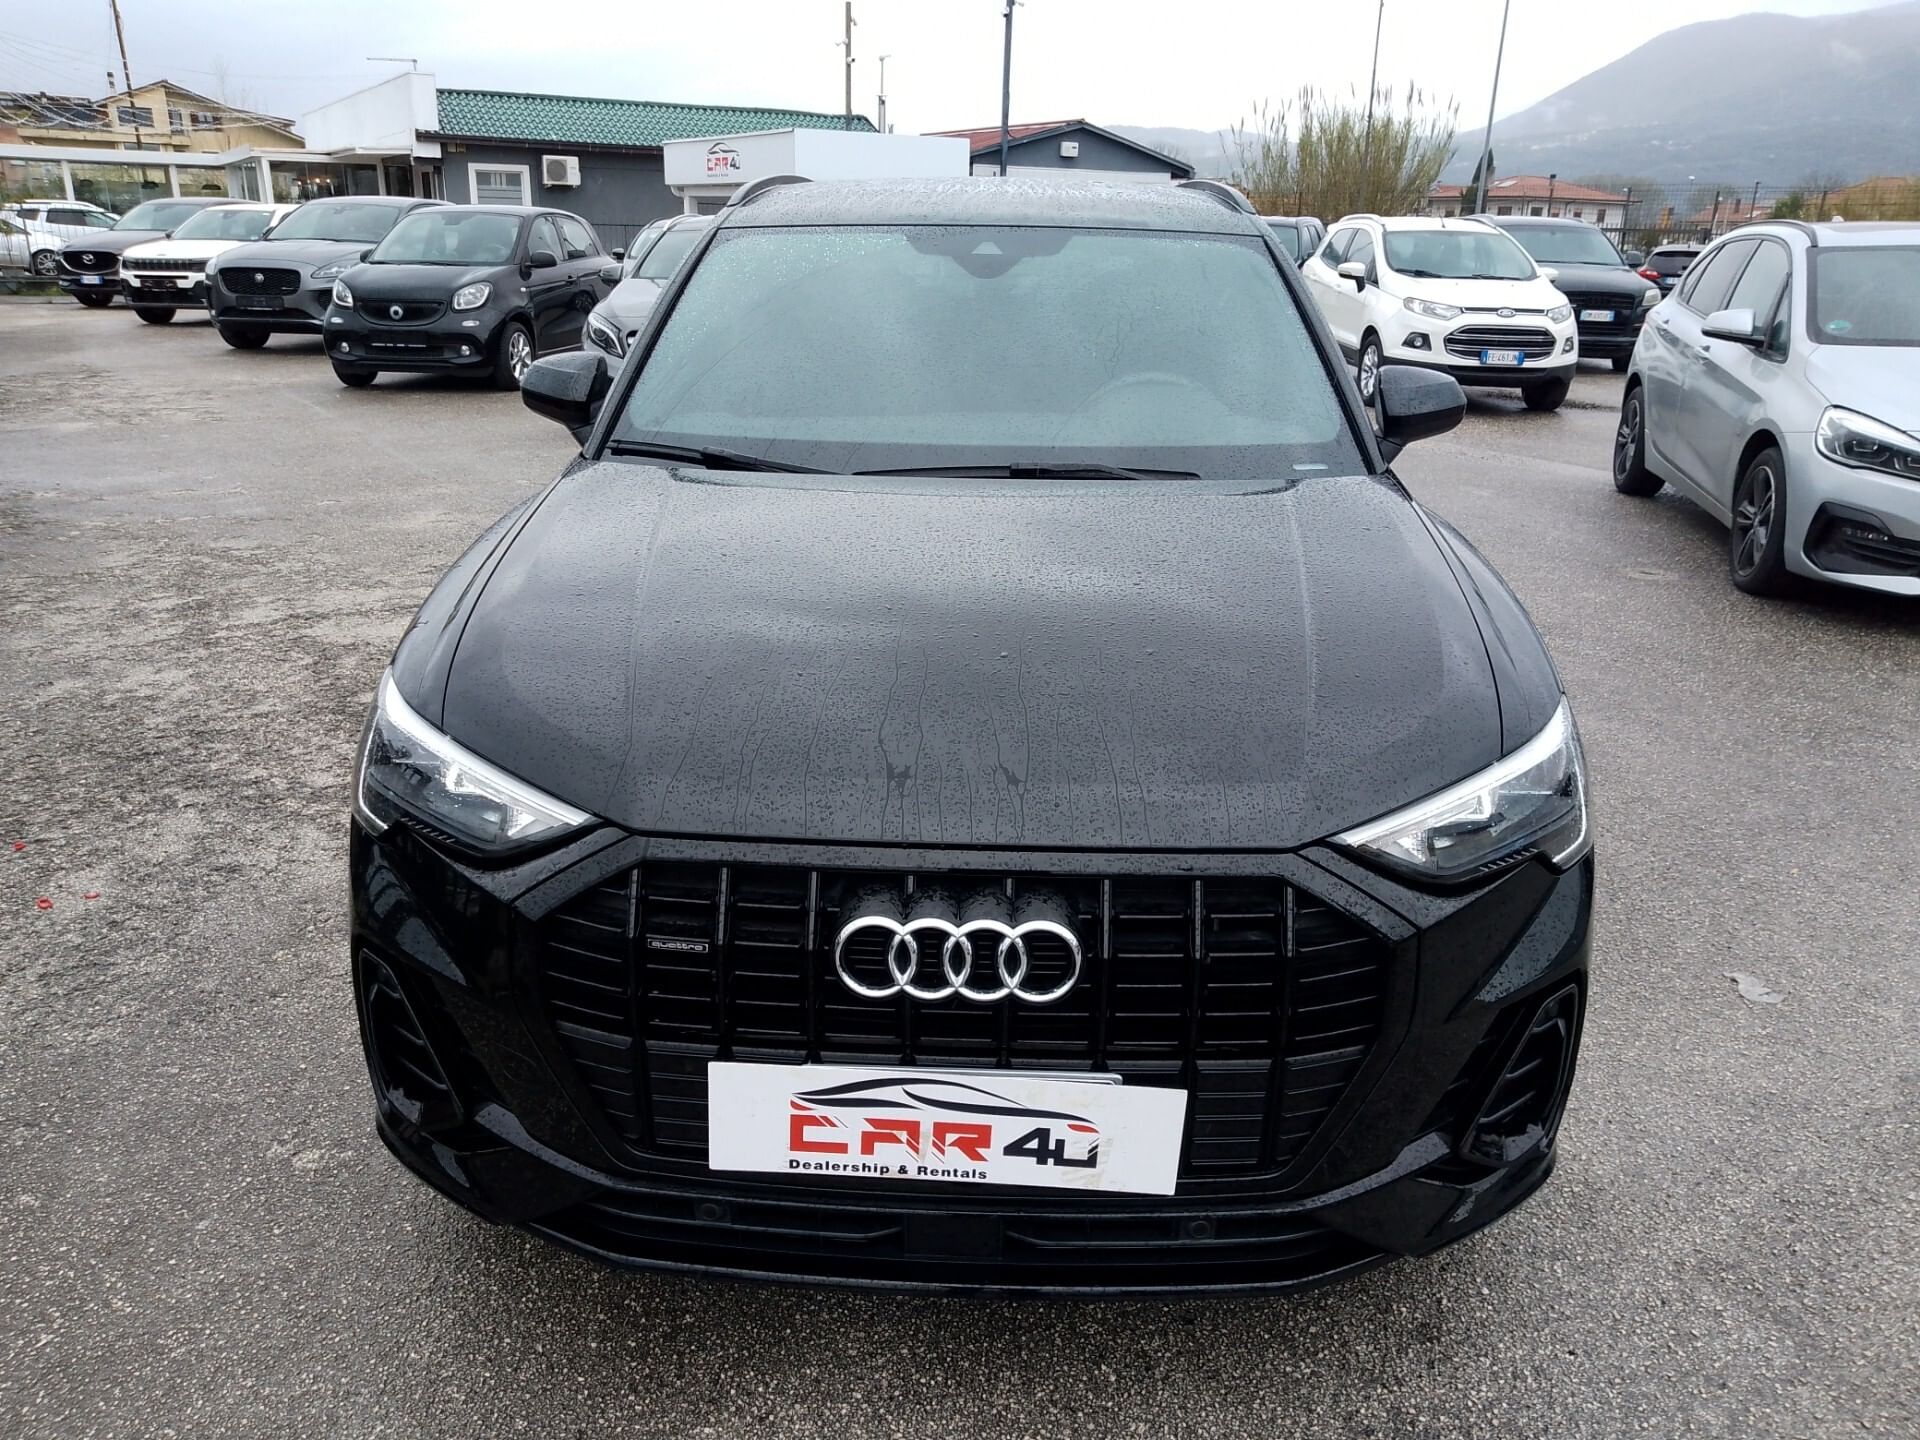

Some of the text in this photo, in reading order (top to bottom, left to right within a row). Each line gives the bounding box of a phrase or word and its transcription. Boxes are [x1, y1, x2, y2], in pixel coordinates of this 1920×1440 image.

[707, 157, 729, 171] CAR
[789, 1113, 993, 1163] CAR
[788, 1159, 988, 1180] Dealership & Rentals
